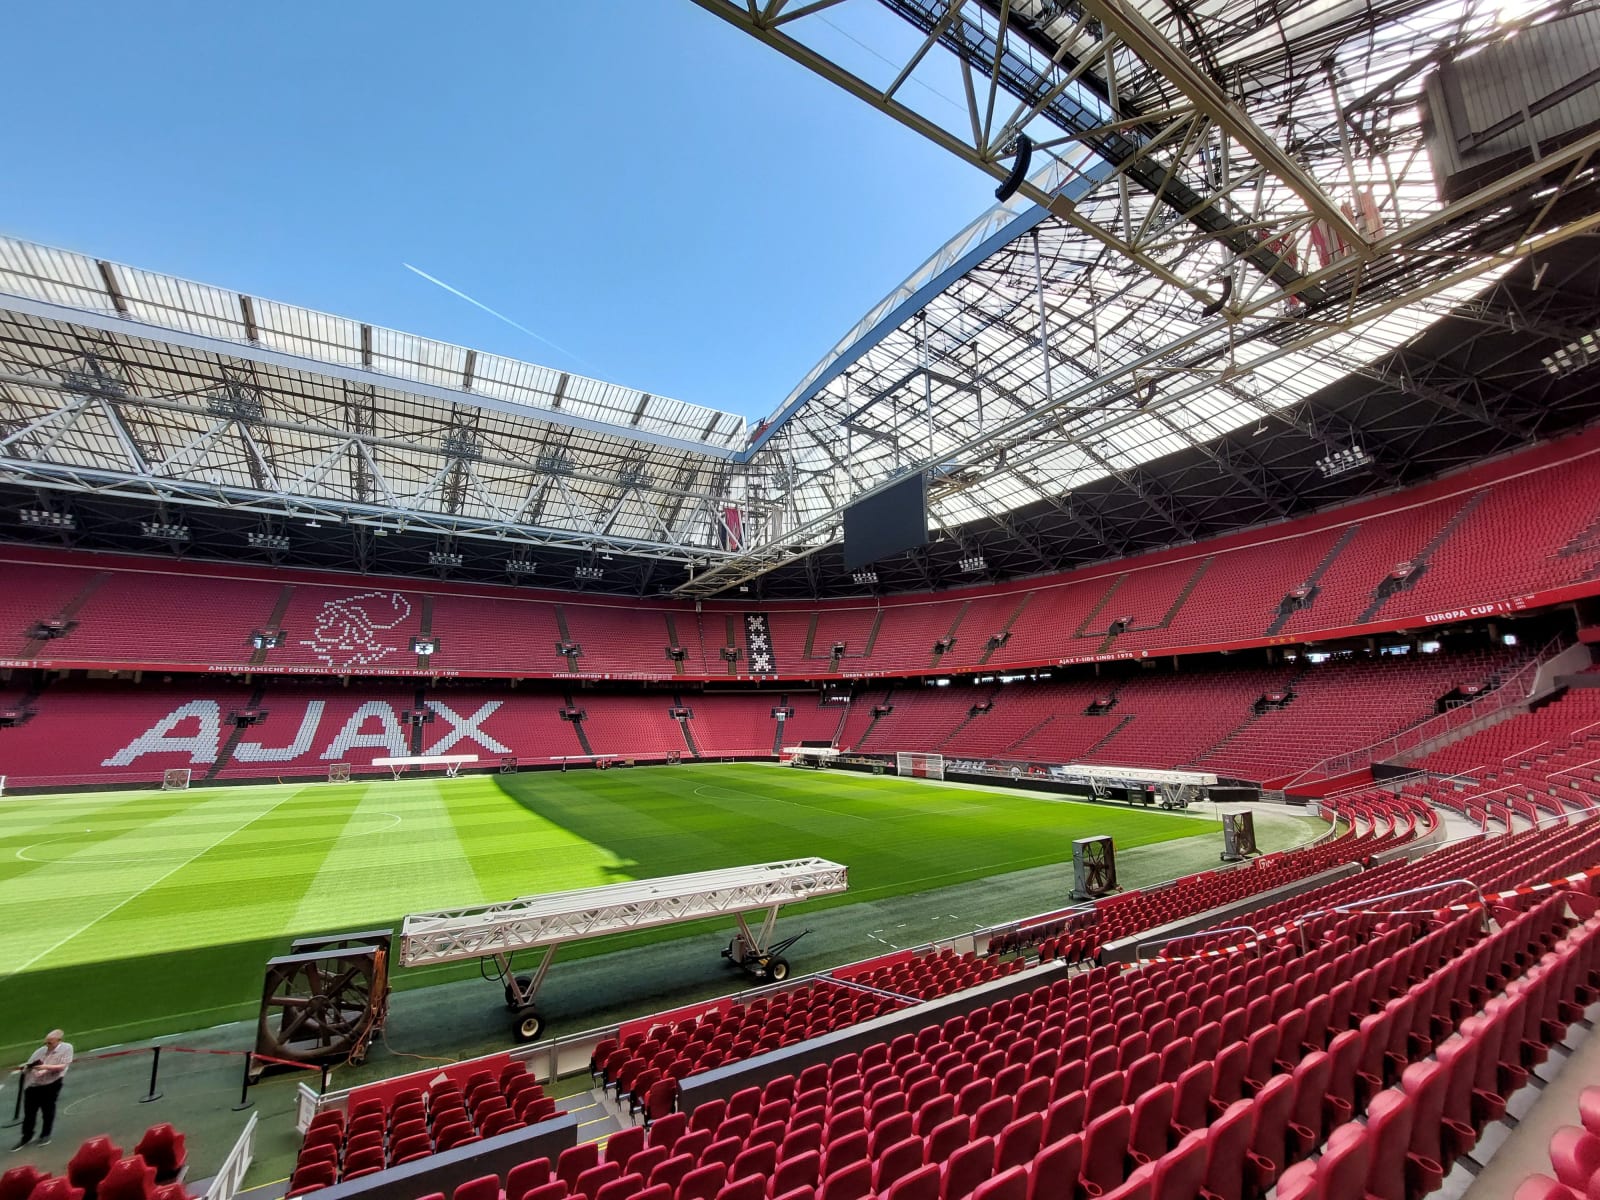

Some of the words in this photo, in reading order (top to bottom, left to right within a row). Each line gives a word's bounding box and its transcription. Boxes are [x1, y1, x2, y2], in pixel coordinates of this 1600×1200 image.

[1424, 609, 1467, 623] EUROPA
[1470, 604, 1494, 615] CUP
[208, 665, 285, 673] AMSTERDAMSCHE
[101, 699, 512, 766] AJAX
